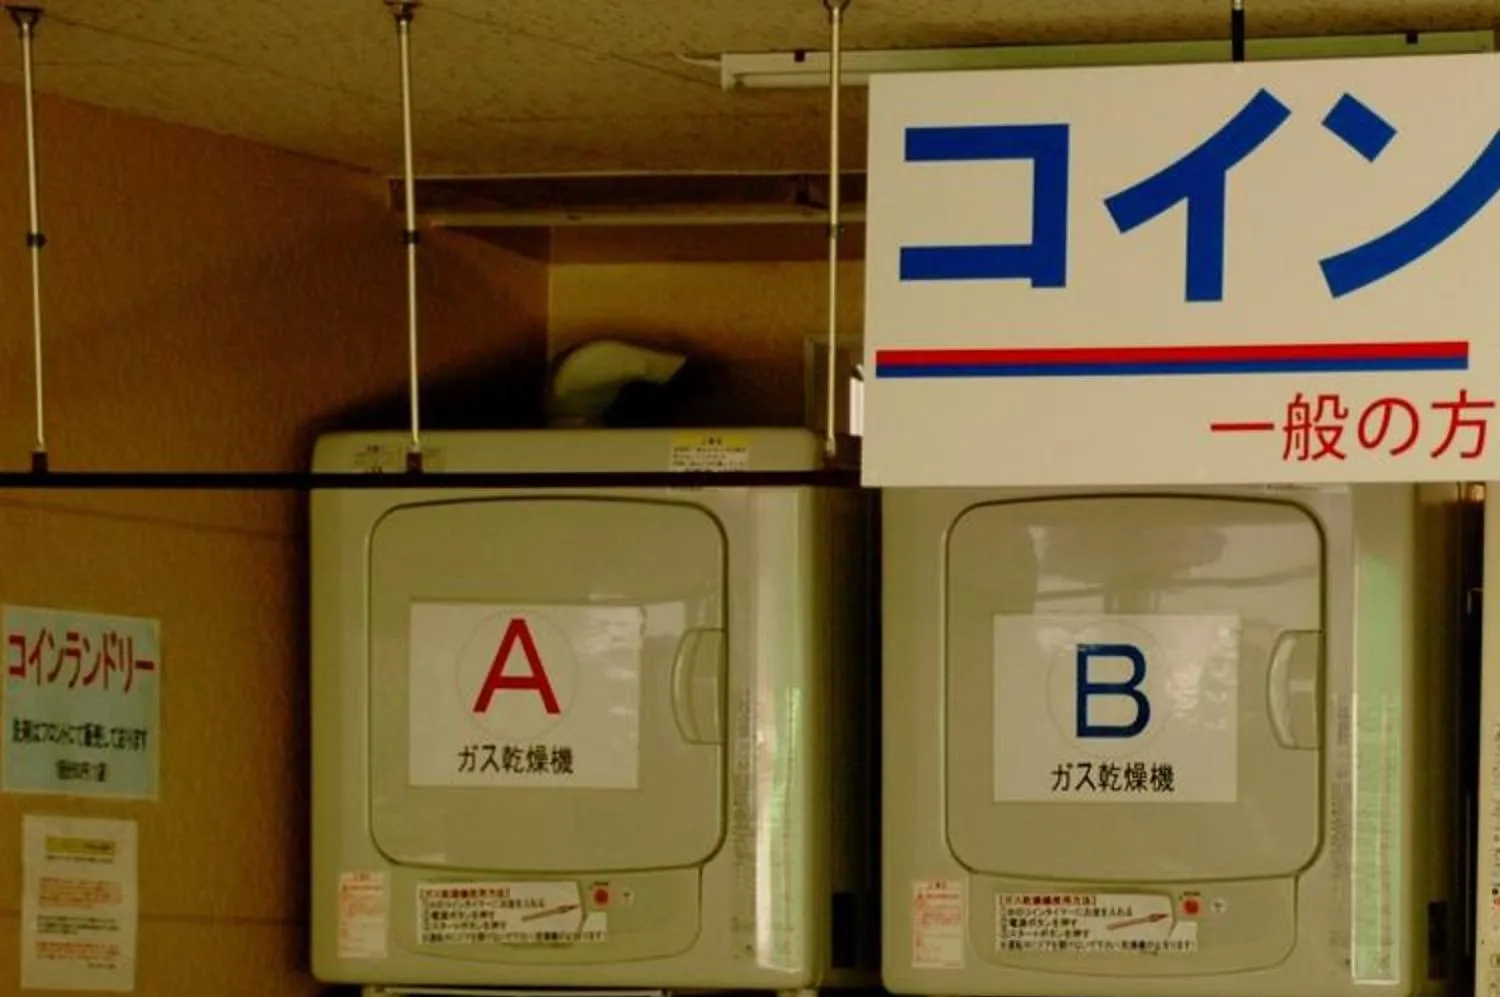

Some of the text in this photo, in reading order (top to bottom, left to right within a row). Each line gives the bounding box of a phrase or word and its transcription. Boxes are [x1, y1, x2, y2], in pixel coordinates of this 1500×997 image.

[8, 627, 155, 694] コインランドリー
[472, 618, 562, 715] A
[1076, 643, 1151, 739] B
[457, 743, 575, 775] ガス乾燥機
[1050, 761, 1176, 793] ガス乾燥機
